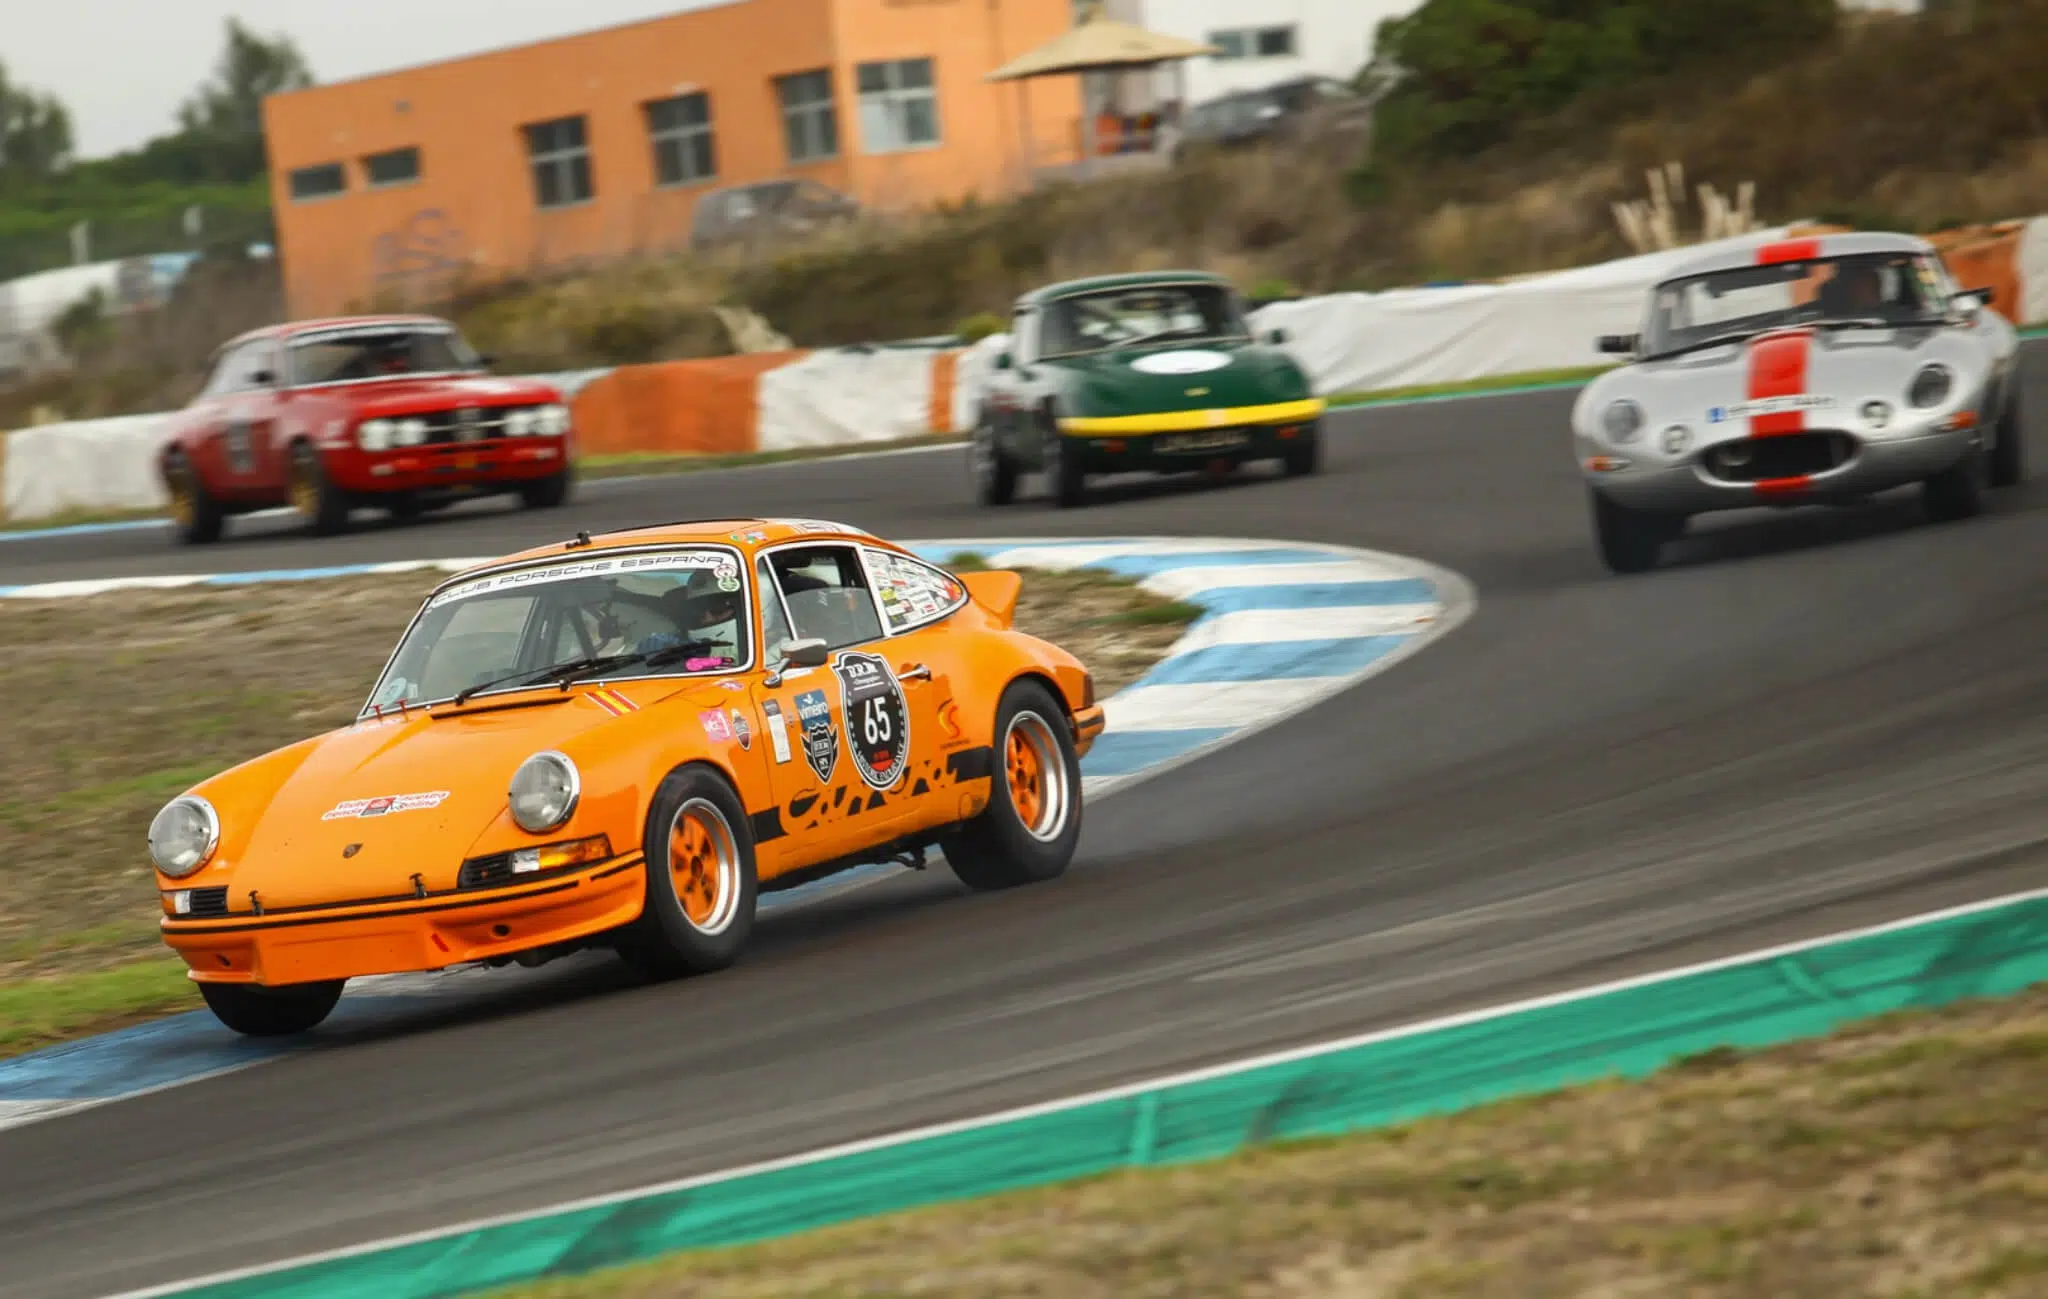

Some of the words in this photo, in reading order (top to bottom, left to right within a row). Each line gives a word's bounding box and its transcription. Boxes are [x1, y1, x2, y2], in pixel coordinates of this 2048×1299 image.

[434, 580, 491, 603] CLUB
[499, 562, 612, 585] PORSCHE
[864, 696, 891, 744] 65
